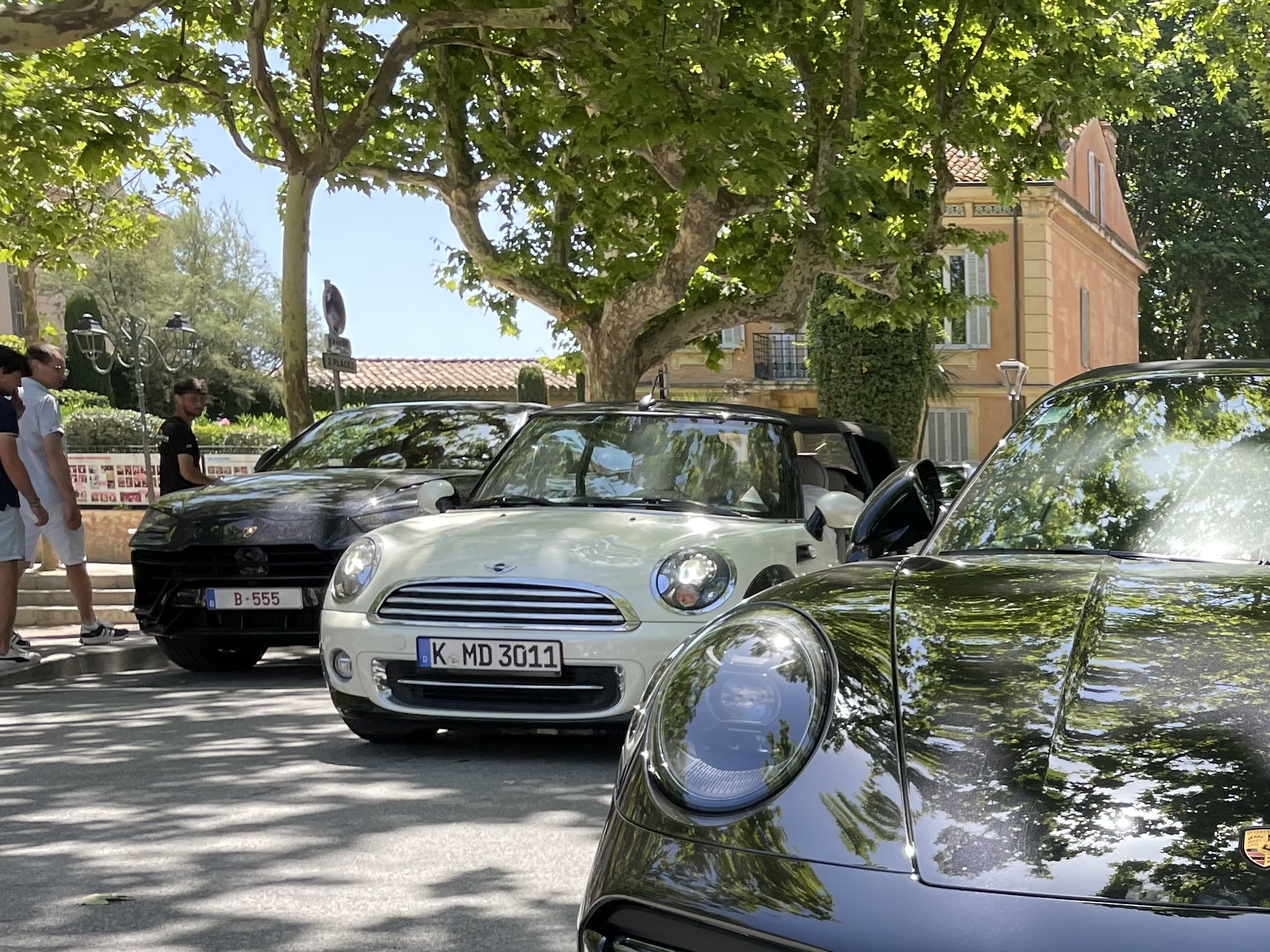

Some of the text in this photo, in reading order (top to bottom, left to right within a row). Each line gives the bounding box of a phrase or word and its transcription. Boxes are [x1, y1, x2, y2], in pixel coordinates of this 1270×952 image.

[432, 641, 558, 669] K MD 3011
